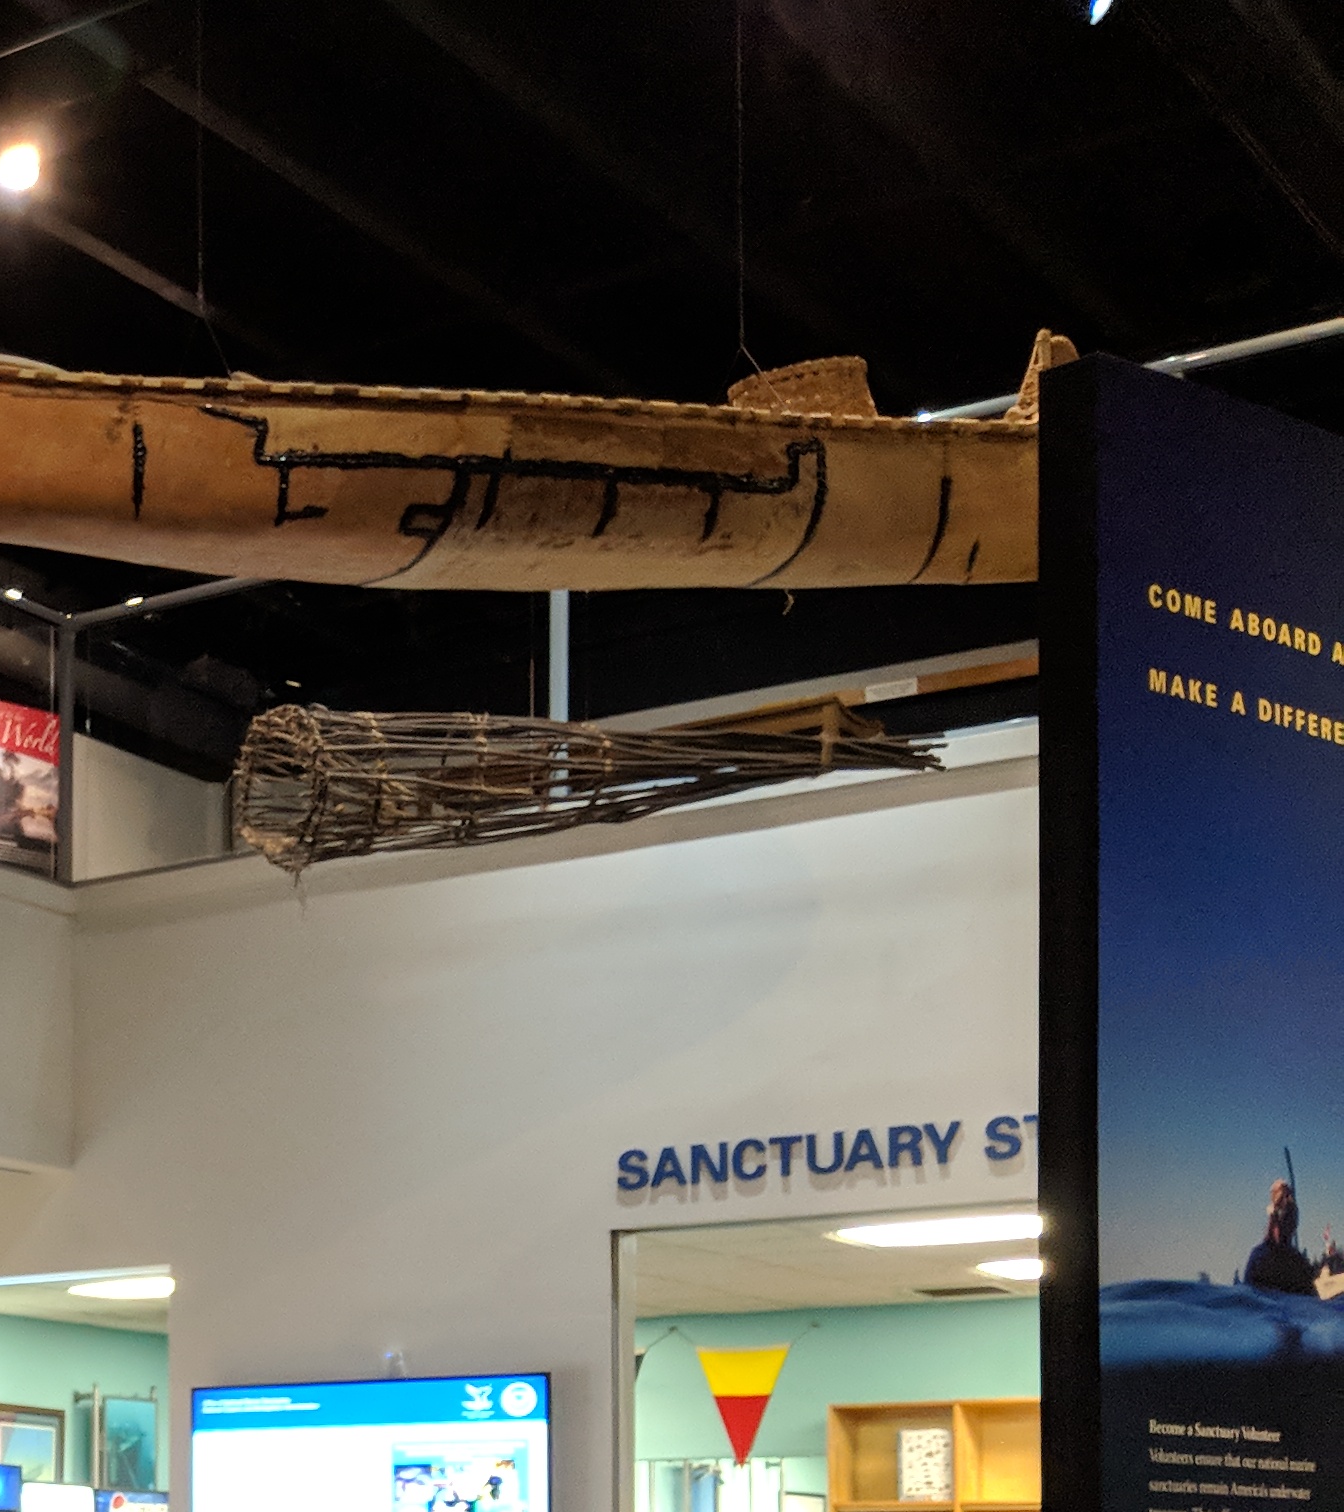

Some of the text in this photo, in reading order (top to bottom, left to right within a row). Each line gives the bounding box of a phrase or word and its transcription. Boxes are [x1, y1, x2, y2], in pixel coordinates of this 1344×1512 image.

[1148, 584, 1344, 666] COME ABOARD A
[1149, 667, 1344, 745] MAKE A DIFFERE
[617, 1121, 962, 1192] SANCTUARY
